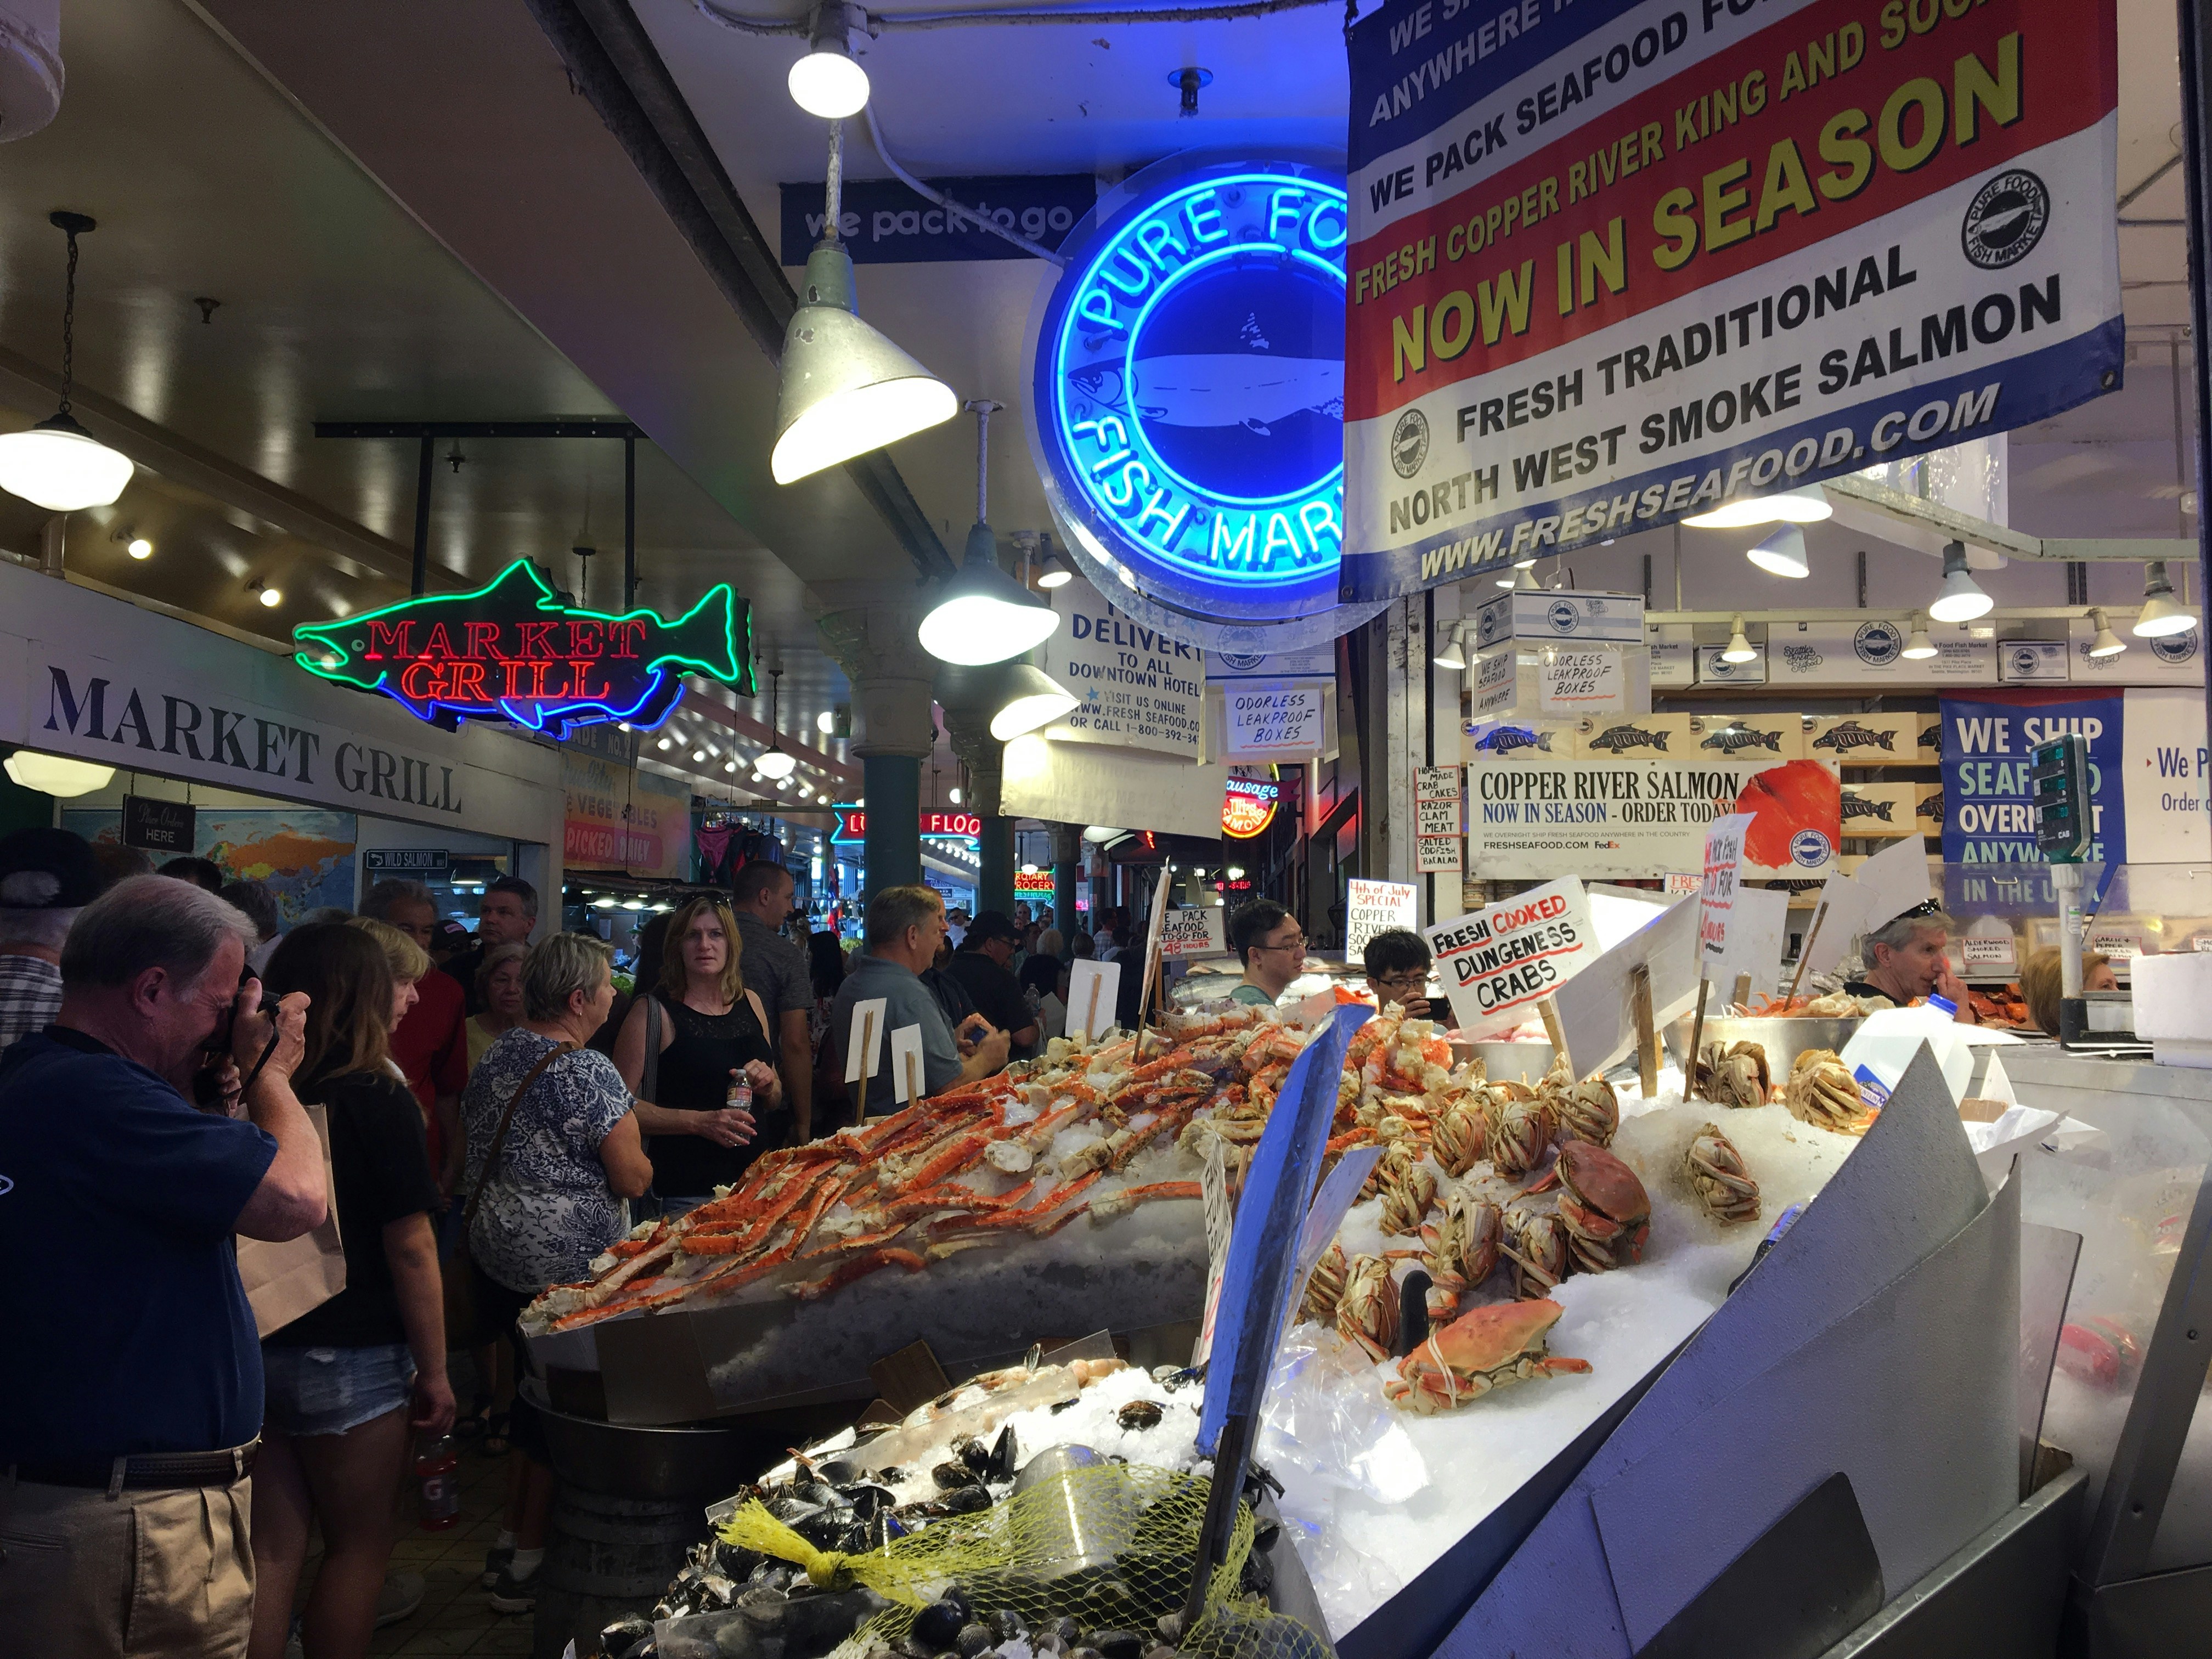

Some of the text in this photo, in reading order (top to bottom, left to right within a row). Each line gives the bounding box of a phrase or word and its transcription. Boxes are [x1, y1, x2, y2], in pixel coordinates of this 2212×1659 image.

[1389, 1, 1432, 55] WE
[1369, 0, 1541, 127] ANYWHERE
[1370, 165, 1414, 213] WE
[1426, 113, 1508, 188] PACK
[1516, 11, 1688, 135] SEAFOOD
[1355, 20, 1865, 304] FRESH COPPER RIVER KING AND
[1392, 31, 2024, 384] NOW IN SEASON
[1970, 176, 2038, 221] PURE FOOD
[873, 188, 967, 241] pack
[979, 202, 1015, 234] to
[1021, 205, 1073, 240] go
[1968, 214, 2043, 263] FISH MARKET
[1079, 189, 1228, 329] PURE
[1457, 245, 1917, 443] FRESH TRADITIONAL
[1390, 273, 2062, 535] NORTH WEST SMOKE SALMON
[1395, 413, 1425, 442] PURE FOOD
[1394, 454, 1406, 473] FISH
[1074, 415, 1190, 545] FISH
[1421, 382, 2001, 581] WWW.FRESHSEAFOOD.COM
[366, 620, 647, 659] MARKET
[1858, 622, 1897, 639] PURE FOOD
[1544, 654, 1603, 667] ODORLESS
[1784, 645, 1816, 658] Seattle's
[1858, 645, 1899, 664] FISH MARKET
[2154, 641, 2196, 661] FISH MARKET
[1118, 652, 1173, 675] TO ALL
[1481, 654, 1509, 676] WE SHIP
[1548, 665, 1611, 681] LEAKPROOF
[1791, 656, 1823, 674] Seafood
[402, 661, 608, 701] GRILL
[1070, 662, 1156, 687] DOWNTOWN
[1478, 668, 1506, 689] SEAFOOD
[1555, 680, 1596, 695] BOXES
[1104, 690, 1186, 715] VISIT US ONLINE
[1235, 694, 1305, 710] ODORLESS
[1479, 689, 1510, 712] ANYWHERE
[1070, 716, 1087, 729] OR
[1094, 718, 1121, 731] CALL
[1237, 708, 1316, 727] LEAKPROOF
[43, 665, 319, 785] MARKET
[334, 741, 462, 814] GRILL
[1254, 726, 1302, 743] BOXES
[1957, 718, 2103, 754] WE SHIP
[608, 733, 622, 757] NO.
[1418, 766, 1441, 775] HOME
[2157, 747, 2188, 777] We
[1417, 781, 1438, 791] CRAB
[1430, 772, 1454, 781] MADE
[1481, 771, 1740, 802] COPPER RIVER SALMON
[1227, 780, 1278, 800] ausage
[1429, 787, 1458, 799] CAKES
[578, 794, 657, 829] VEGETABLES
[1421, 802, 1452, 810] RAZOR
[2162, 792, 2200, 811] Order
[1419, 810, 1448, 821] CLAM
[1483, 803, 1737, 823] NOW IN SEASON ORDER TODAY!
[146, 828, 174, 843] HERE
[1425, 822, 1454, 833] MEAT
[567, 827, 650, 862] PICKED DAILY
[1419, 838, 1451, 847] SALTED
[1594, 840, 1620, 849] FedEx
[1795, 832, 1827, 845] PURE FOOD
[385, 853, 402, 866] WILD
[404, 853, 433, 867] SALMON
[1420, 847, 1456, 855] CODFISH
[1794, 851, 1827, 865] FISH MARKET
[1016, 882, 1054, 890] ROCERY
[1350, 881, 1410, 900] 4th of July
[1718, 870, 1733, 898] FOR
[1963, 879, 1987, 901] IN
[1997, 879, 2033, 902] THE
[1357, 894, 1401, 907] SPECIAL
[1182, 910, 1207, 922] PACK
[1351, 908, 1396, 922] COPPER
[1432, 895, 1566, 954] FRESH COOKED
[1163, 942, 1182, 955] 48
[1454, 922, 1576, 983] DUNGENESS
[1477, 960, 1557, 1009] CRABS
